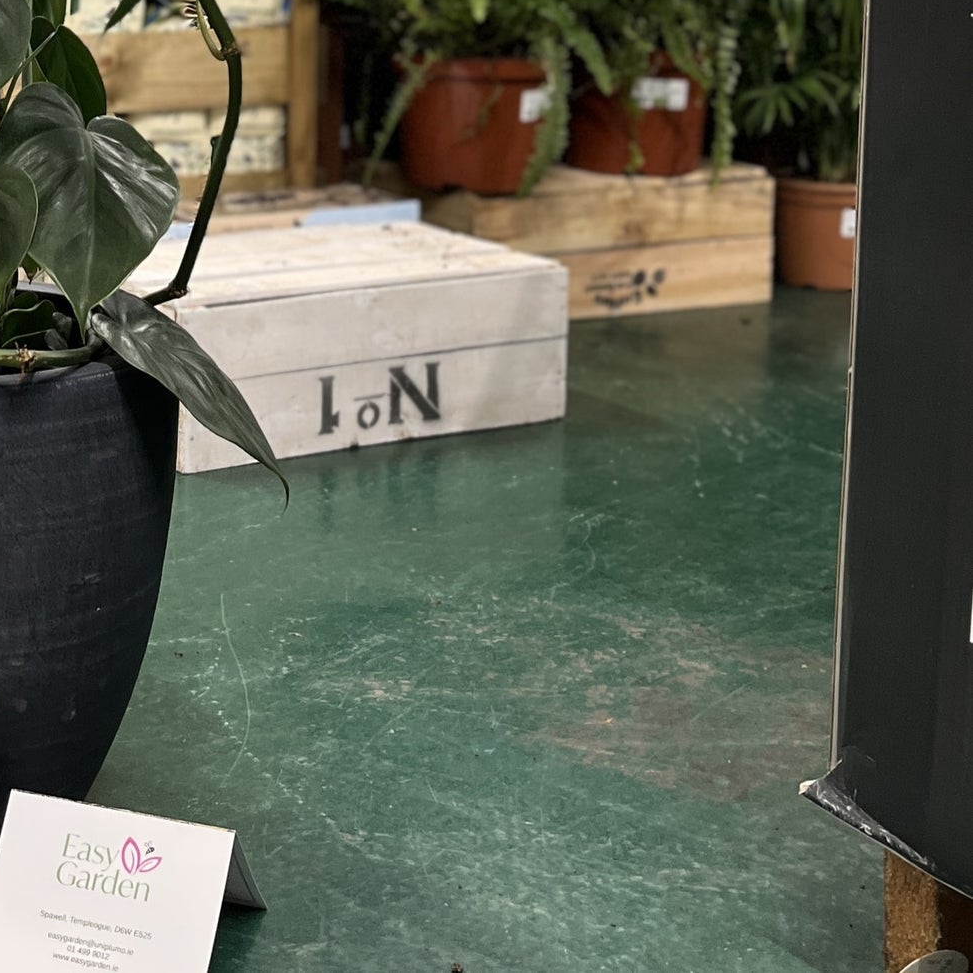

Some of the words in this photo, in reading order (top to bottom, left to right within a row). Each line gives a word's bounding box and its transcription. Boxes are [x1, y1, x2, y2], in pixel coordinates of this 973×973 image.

[62, 833, 120, 871] Easy
[56, 861, 151, 902] Garden
[114, 925, 132, 936] D6W
[66, 945, 75, 953] 01
[77, 947, 91, 956] 499
[92, 950, 110, 960] 9012
[52, 953, 119, 972] www.easygarden.ie
